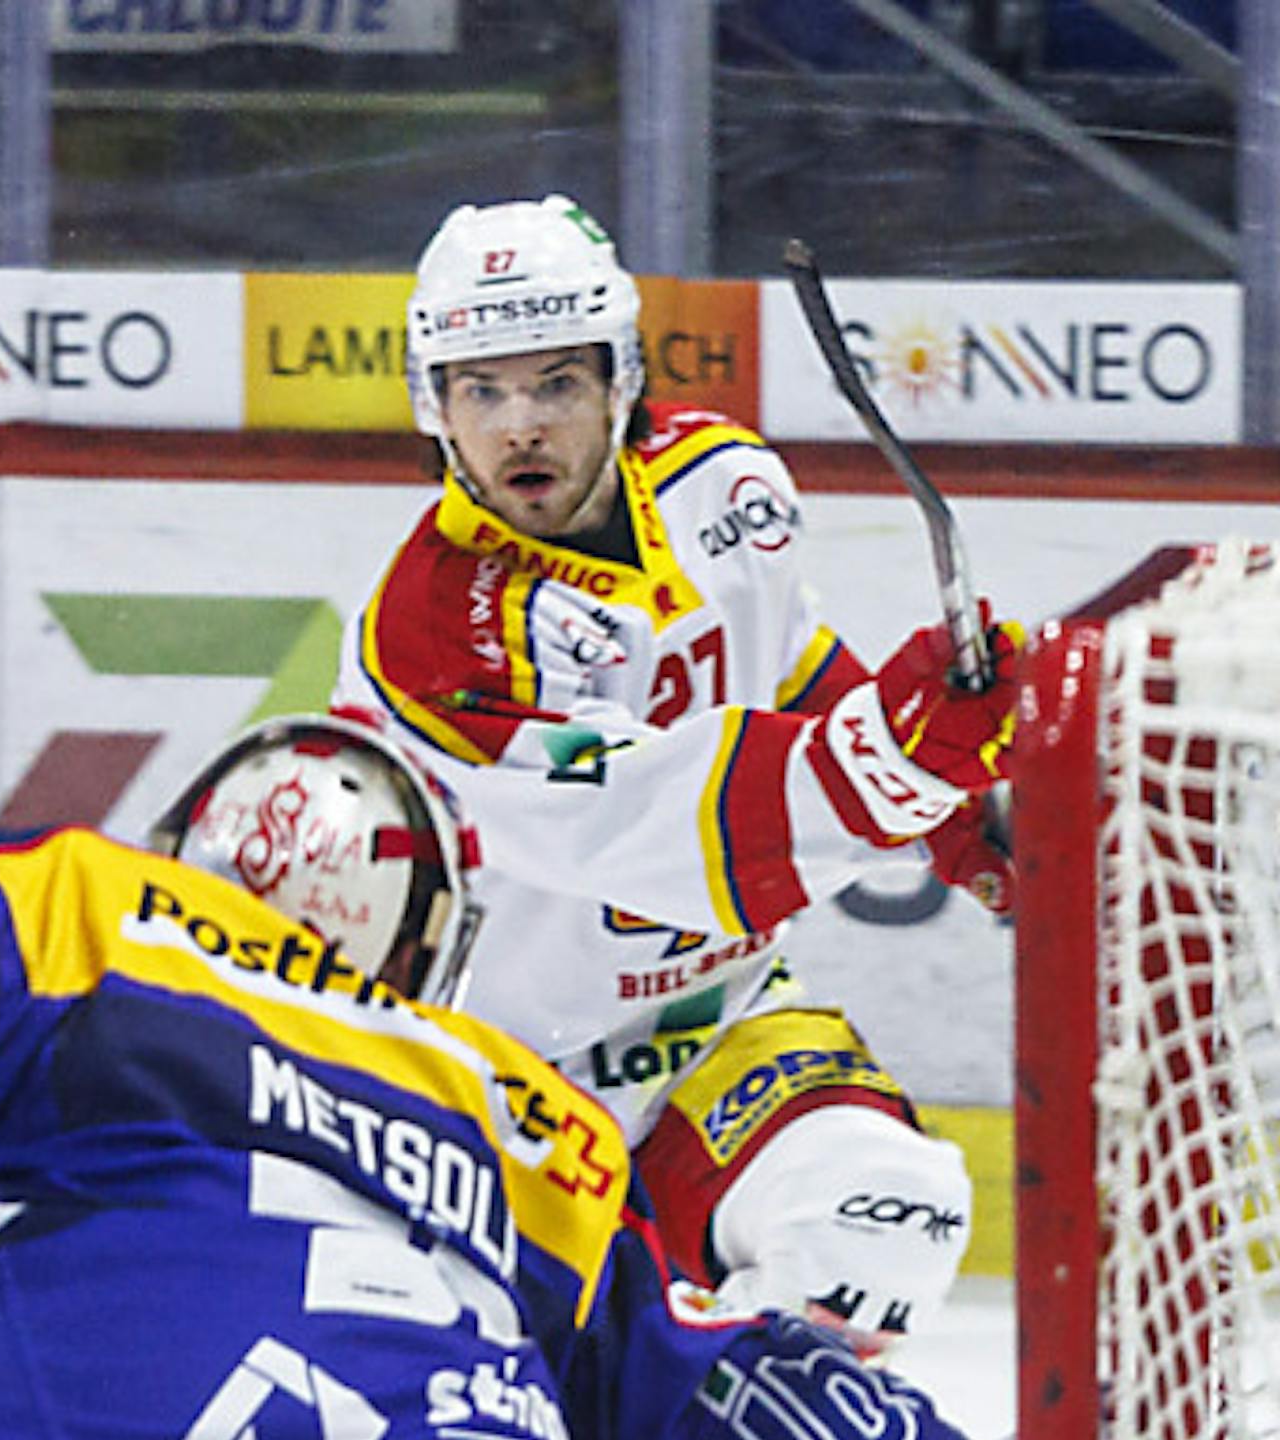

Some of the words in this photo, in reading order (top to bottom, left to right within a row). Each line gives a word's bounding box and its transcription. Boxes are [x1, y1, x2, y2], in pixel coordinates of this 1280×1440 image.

[483, 250, 516, 274] 27
[471, 522, 618, 598] FANUC
[645, 624, 726, 731] 27
[248, 1042, 517, 1280] METSOL
